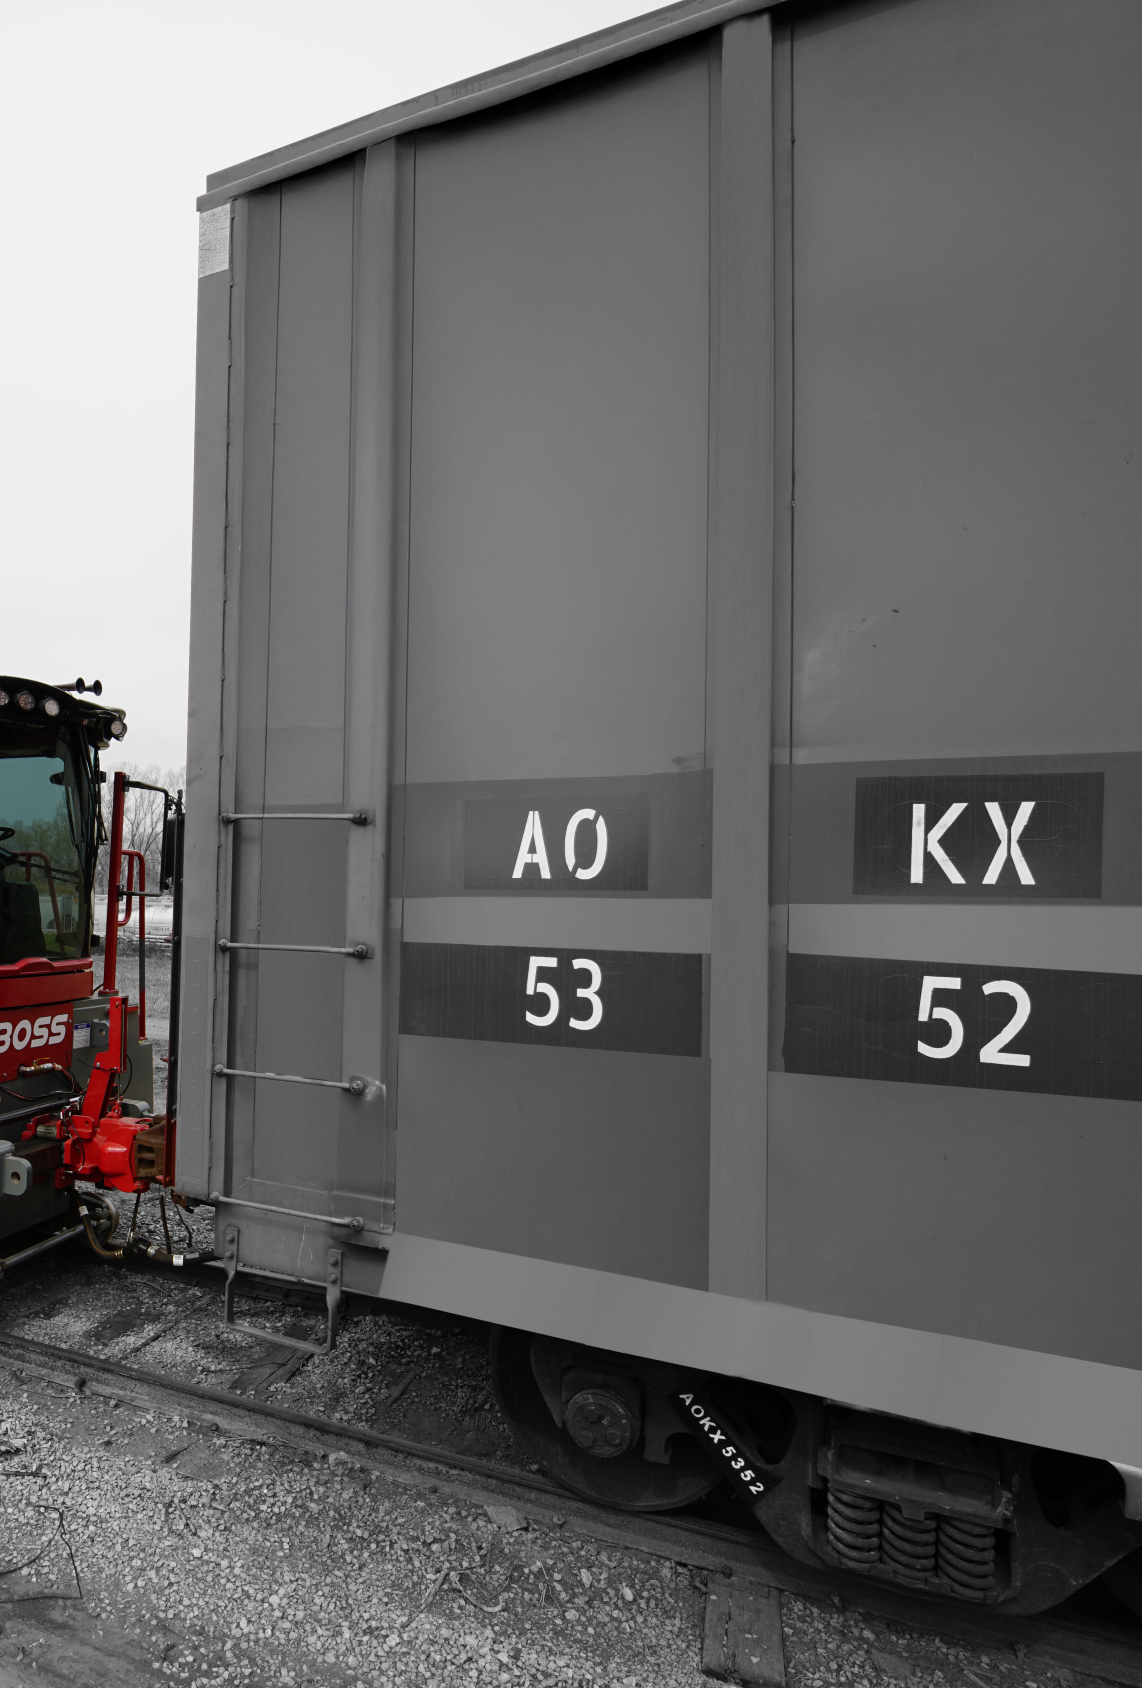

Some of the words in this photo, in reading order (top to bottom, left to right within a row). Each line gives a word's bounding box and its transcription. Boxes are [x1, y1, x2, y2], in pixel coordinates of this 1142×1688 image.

[511, 807, 608, 880] AO
[910, 801, 1036, 886] KX
[525, 956, 603, 1031] 53
[917, 975, 1031, 1067] 52
[679, 1393, 726, 1443] AOKX
[722, 1446, 764, 1495] 5352
